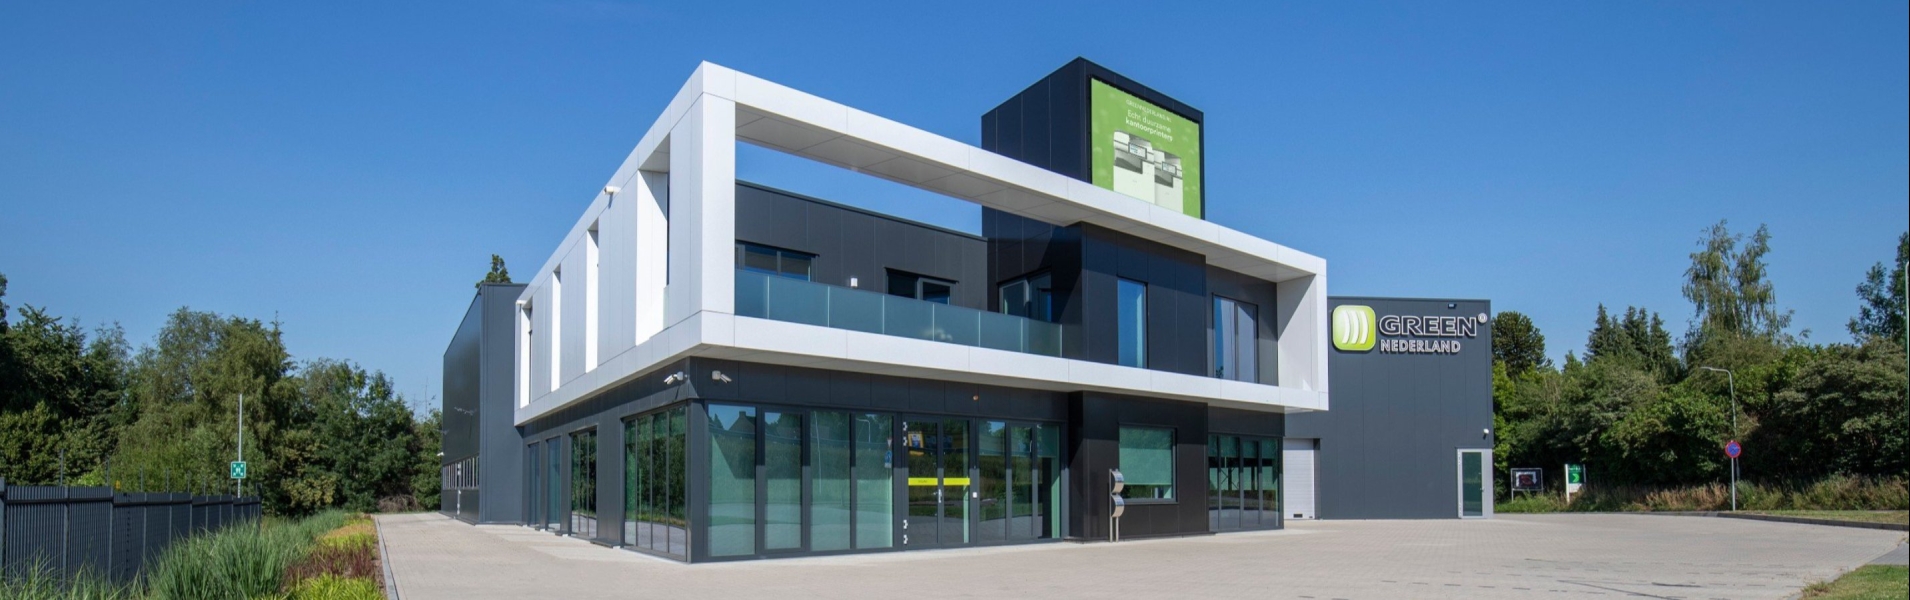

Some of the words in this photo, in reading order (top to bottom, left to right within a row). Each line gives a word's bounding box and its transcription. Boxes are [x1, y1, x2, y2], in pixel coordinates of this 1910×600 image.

[1125, 116, 1173, 142] kantoorprinters
[1379, 315, 1477, 337] GREEN
[1380, 339, 1461, 353] NEDERLAND
